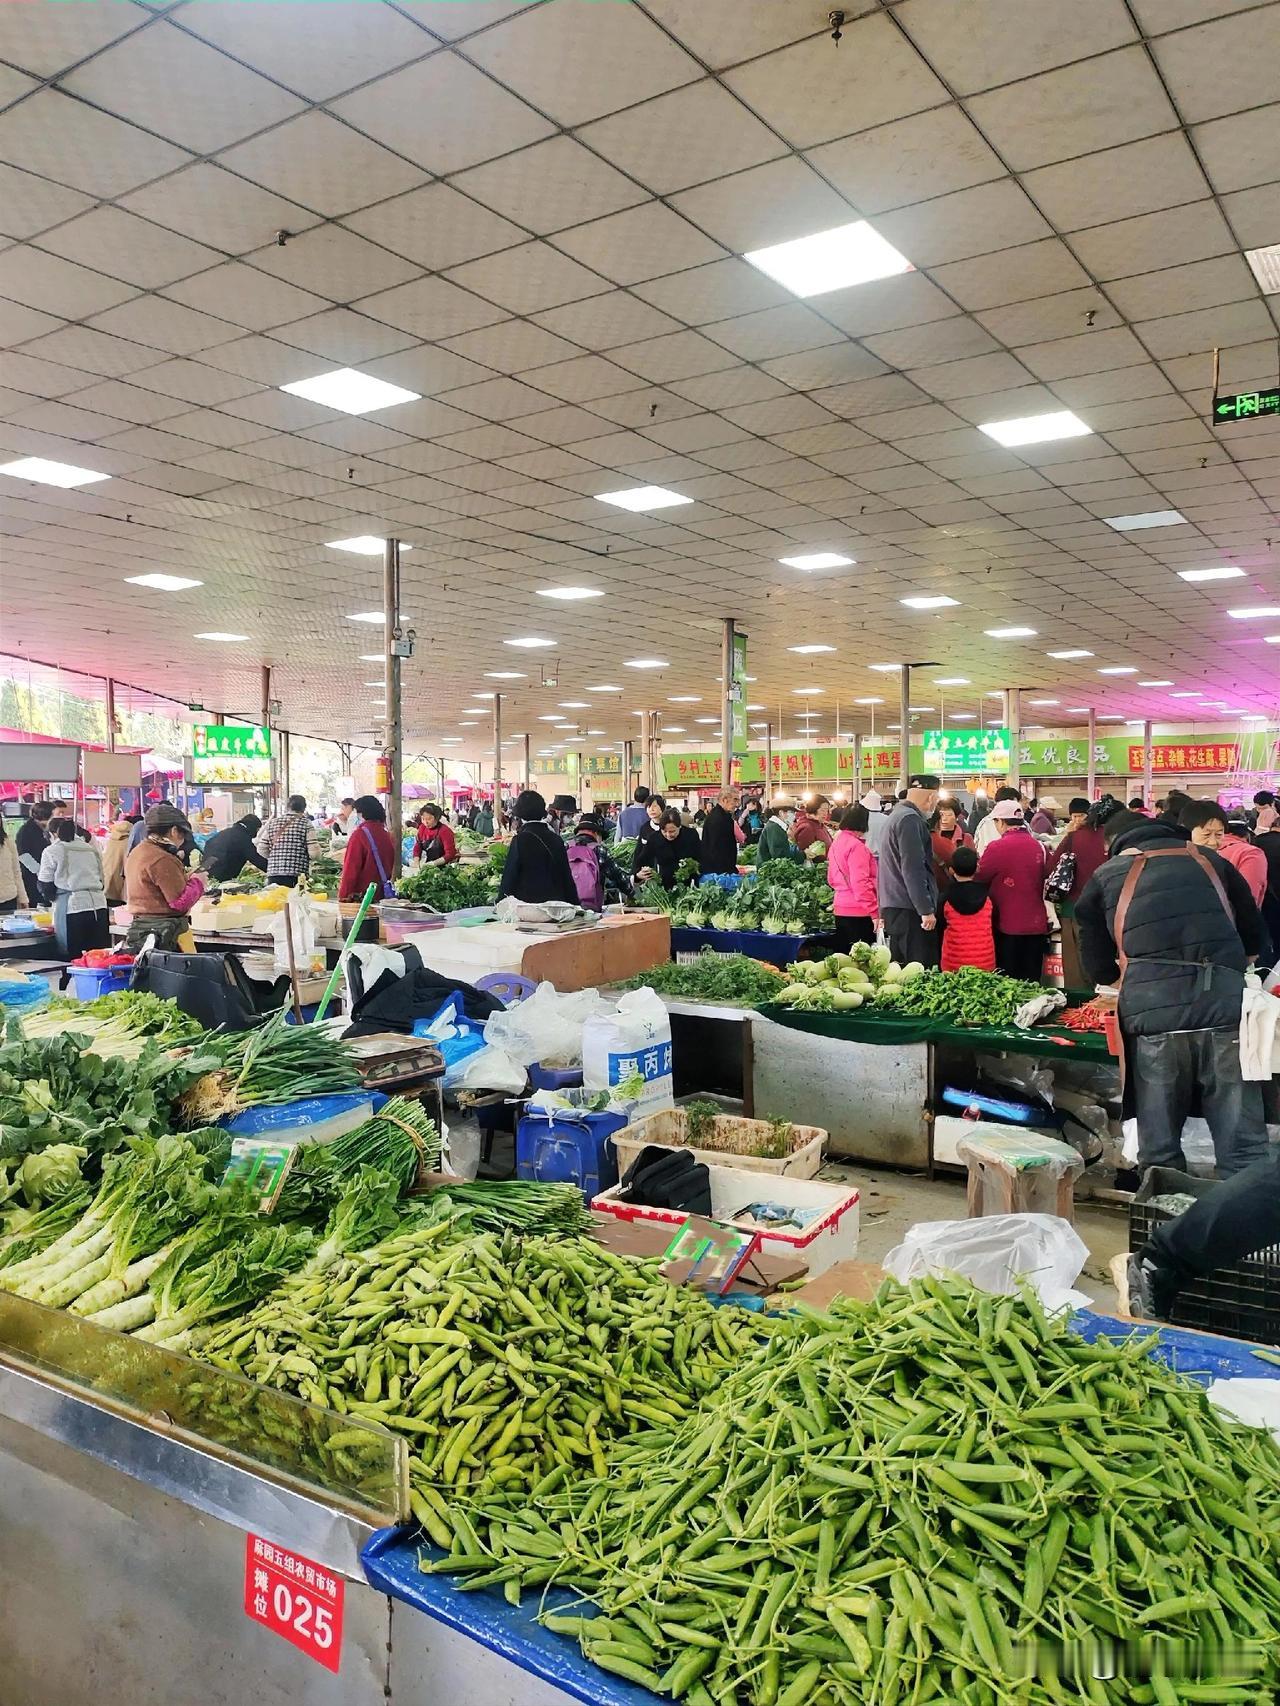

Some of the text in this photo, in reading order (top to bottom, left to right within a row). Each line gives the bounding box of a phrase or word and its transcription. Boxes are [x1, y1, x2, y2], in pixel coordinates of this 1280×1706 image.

[1018, 745, 1110, 765] 五优良品
[253, 1538, 337, 1598] 麻园五组农贸市场
[253, 1567, 269, 1619] 摊位
[273, 1584, 333, 1649] 025
